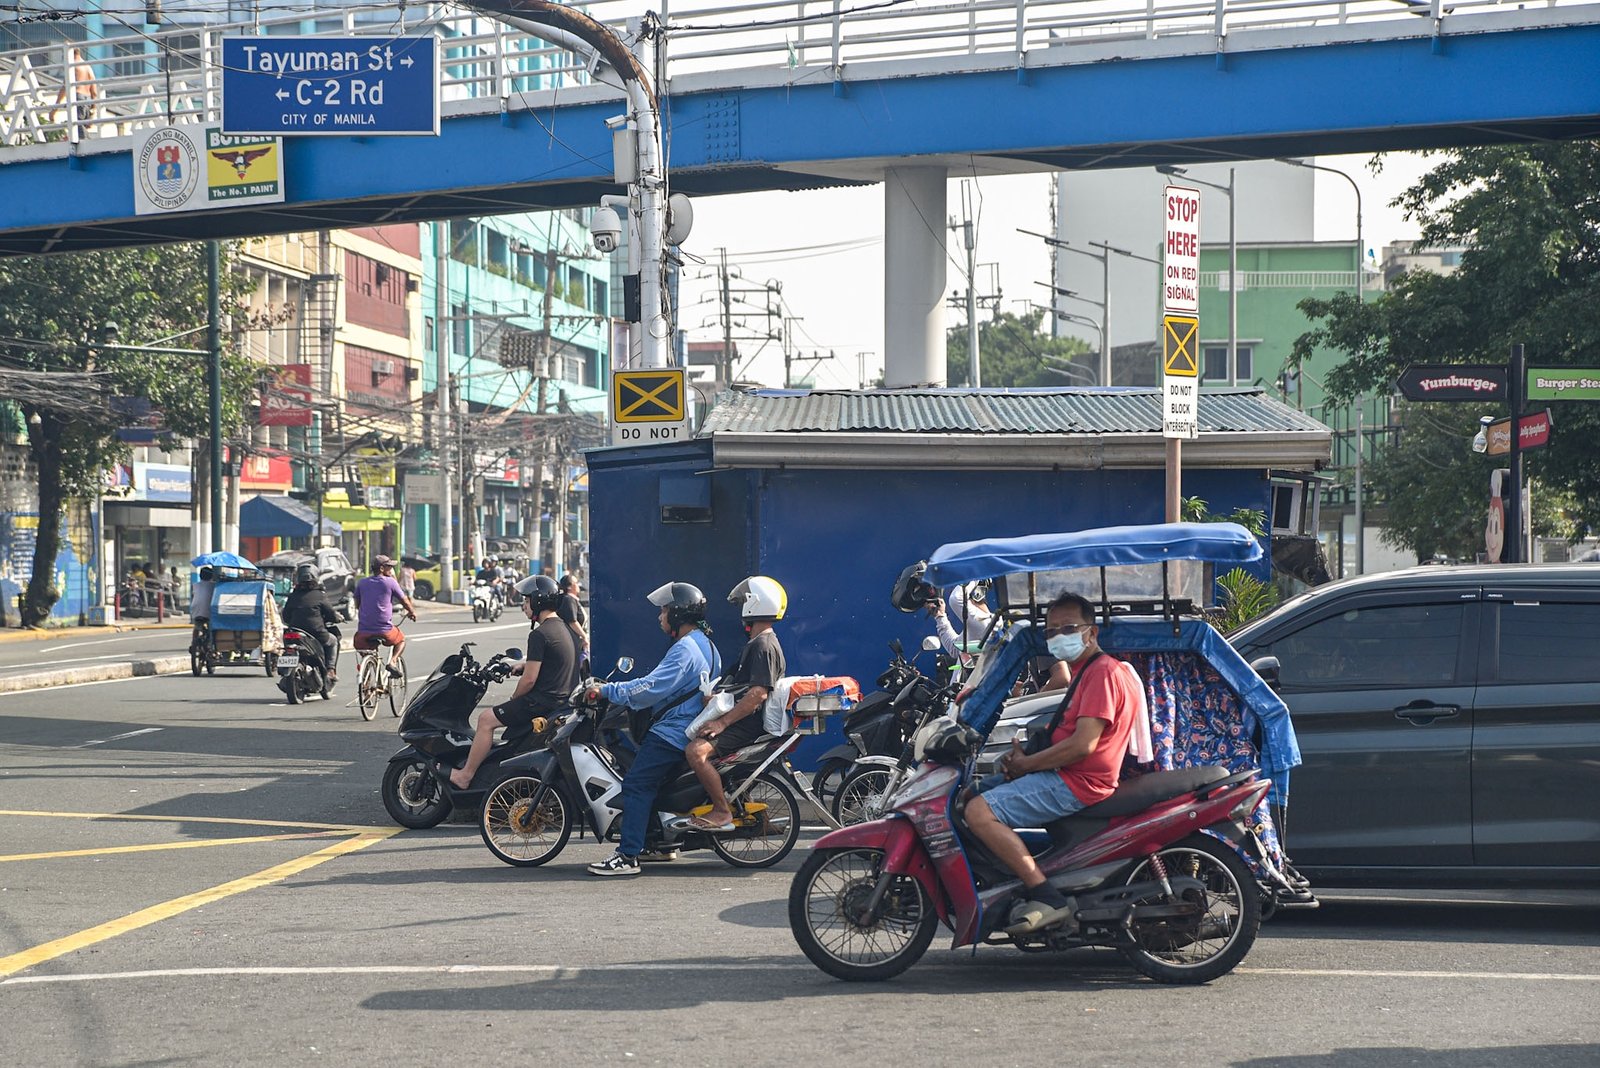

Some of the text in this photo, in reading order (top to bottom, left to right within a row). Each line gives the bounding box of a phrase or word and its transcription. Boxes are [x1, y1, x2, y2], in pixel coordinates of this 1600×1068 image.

[243, 45, 393, 79] Tayuman St
[296, 79, 383, 105] C-2 Rd
[282, 113, 375, 125] CITY OF MANILA
[141, 130, 197, 169] LUNGSOD NG MAYNILA
[212, 189, 227, 198] The
[250, 185, 273, 194] PAINT
[154, 192, 188, 207] PILIPINAS
[1168, 196, 1198, 222] STOP
[1167, 230, 1197, 257] HERE
[1167, 265, 1197, 281] ON RED
[1167, 286, 1196, 301] SIGNAL
[1170, 385, 1192, 396] DO NOT
[1419, 375, 1498, 392] Yumburger
[1536, 377, 1600, 391] Burger Ste
[1171, 403, 1191, 414] BLOCK
[622, 427, 678, 440] DO NOT
